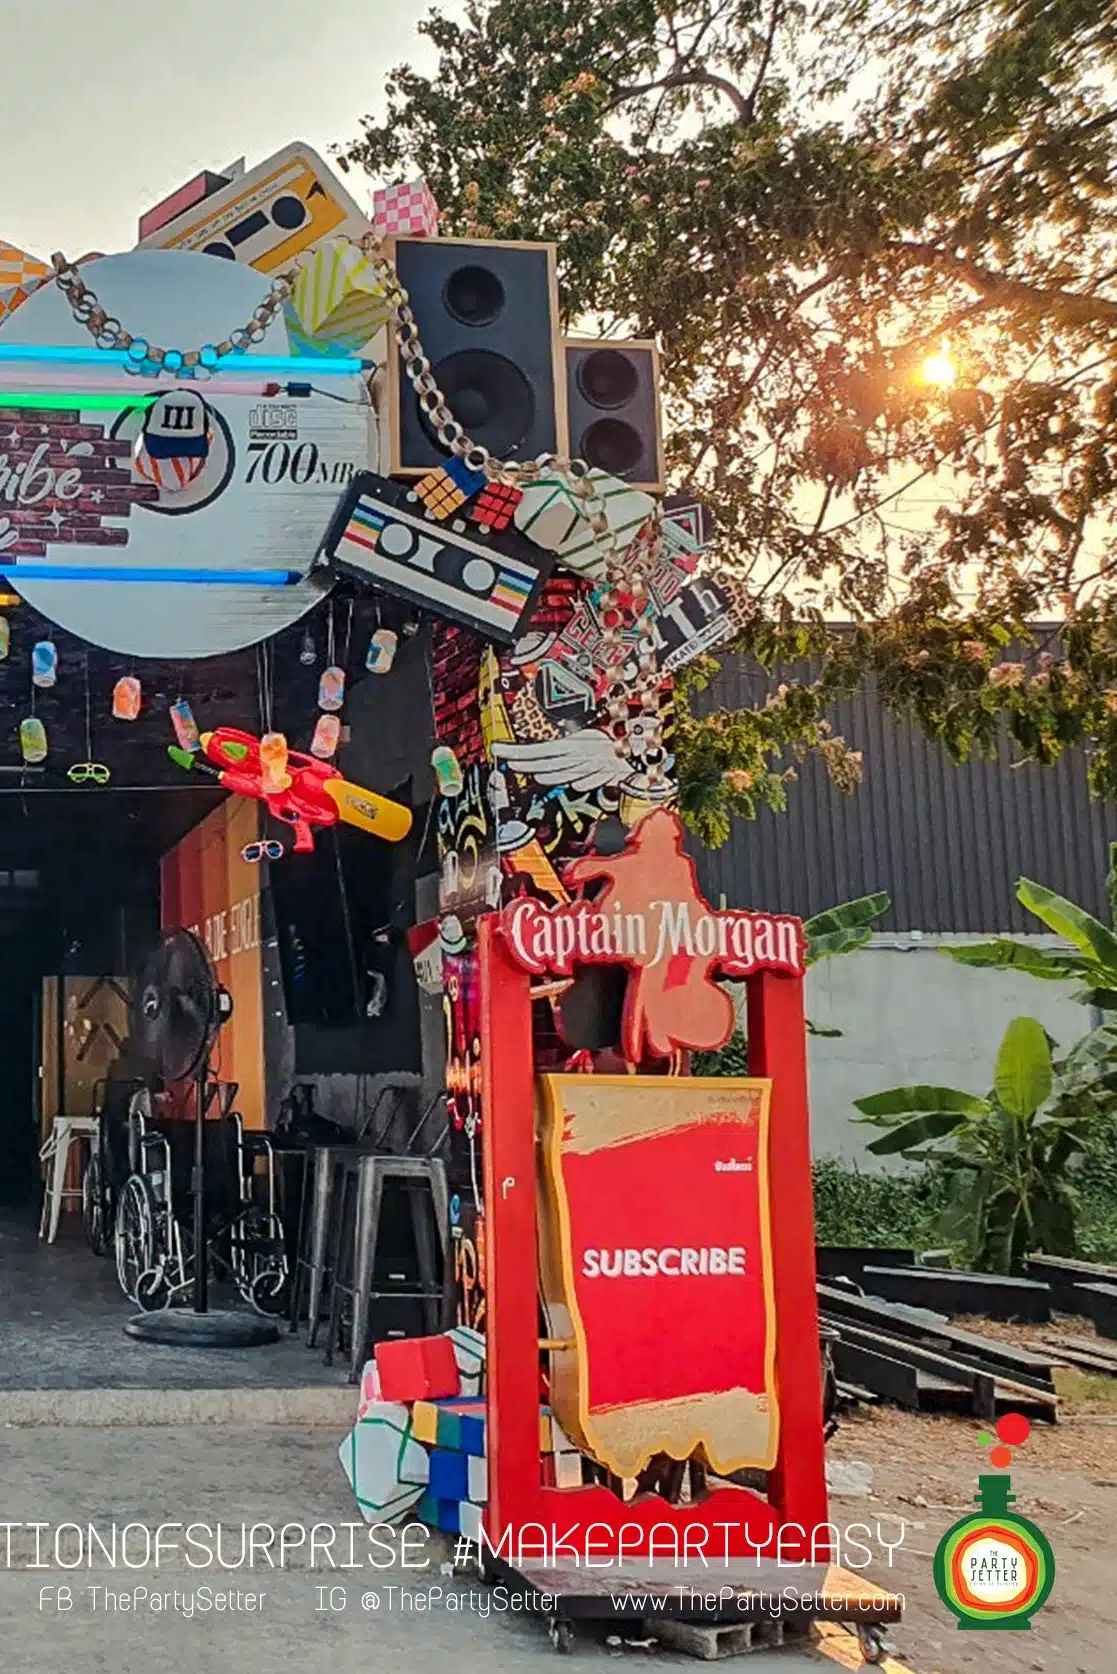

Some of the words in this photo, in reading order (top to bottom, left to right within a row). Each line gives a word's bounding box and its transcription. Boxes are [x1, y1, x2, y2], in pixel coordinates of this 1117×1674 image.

[511, 900, 648, 968] Captain
[647, 900, 801, 969] Morgan
[582, 1247, 747, 1279] SUBSCRIBE
